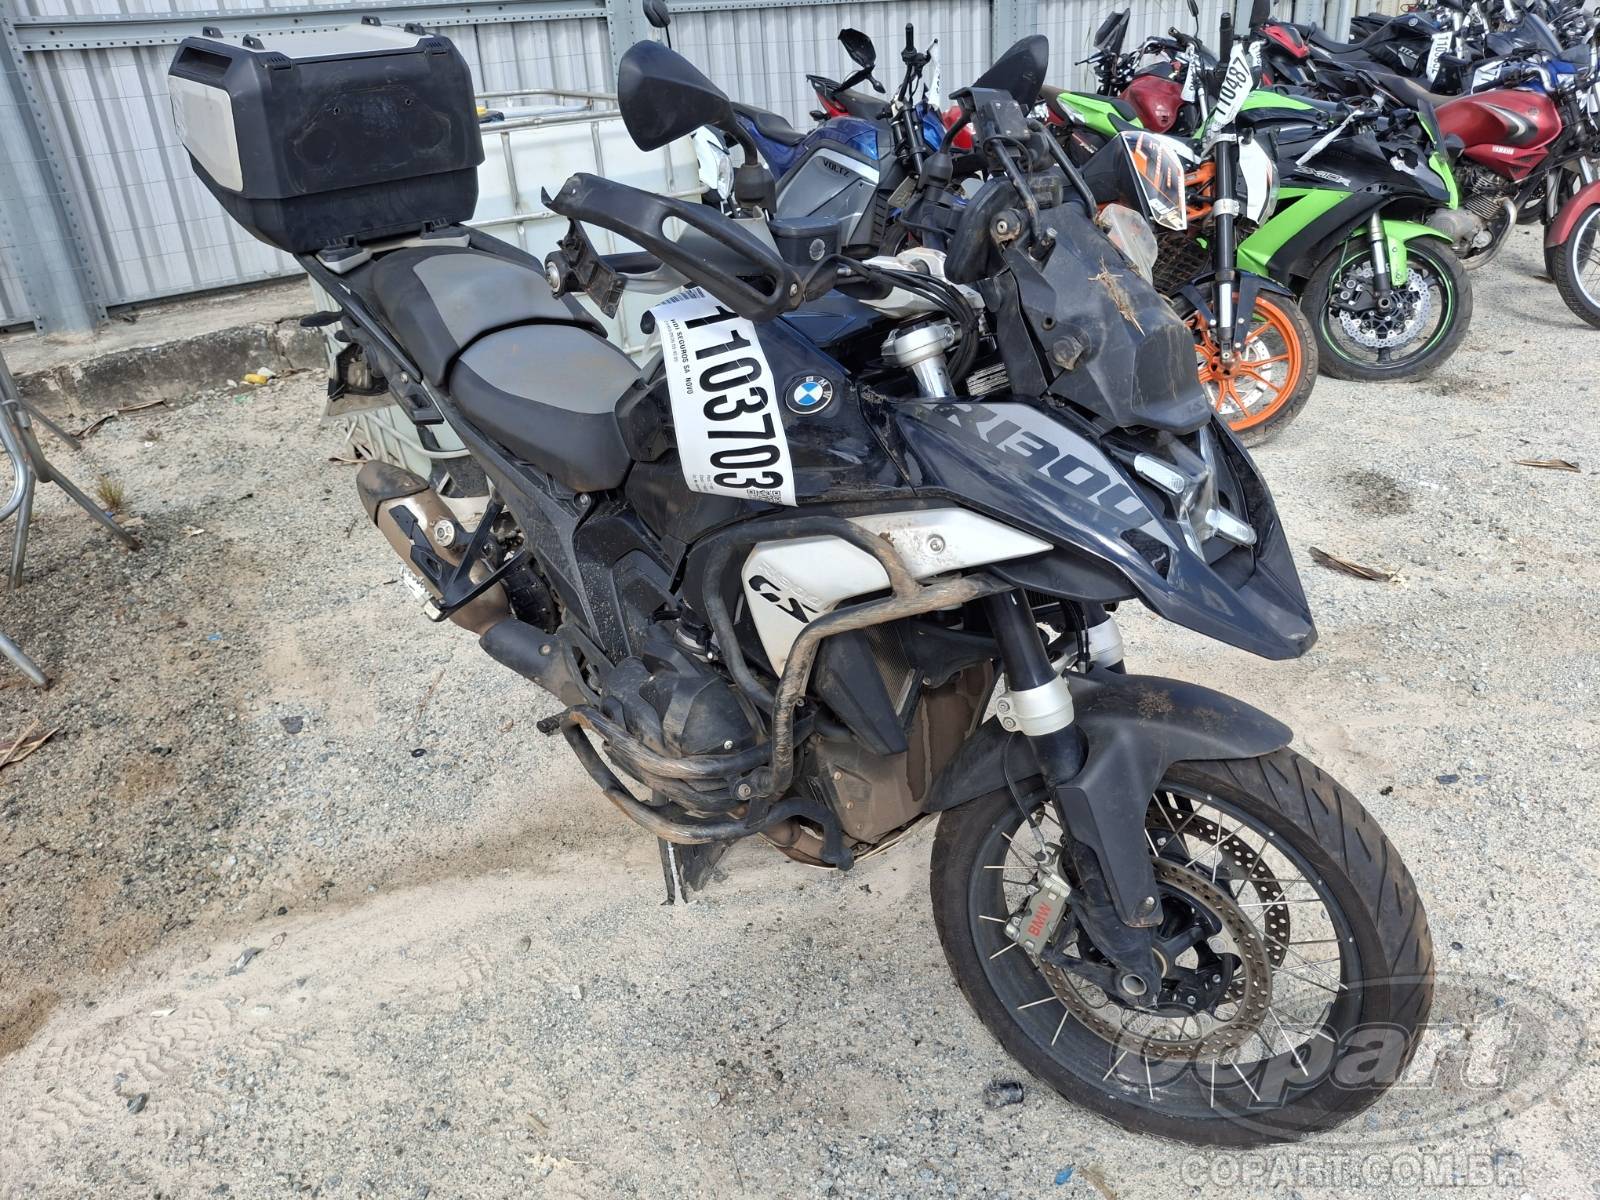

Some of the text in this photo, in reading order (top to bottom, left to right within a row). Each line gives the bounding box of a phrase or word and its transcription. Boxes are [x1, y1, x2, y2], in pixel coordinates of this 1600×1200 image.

[823, 159, 849, 178] VOLTZ
[1492, 144, 1515, 155] YAMAHA
[677, 331, 689, 363] SEGUROS
[686, 377, 694, 395] NOVO
[685, 305, 784, 489] 1103703
[748, 574, 819, 624] GS
[1027, 902, 1052, 938] BMW
